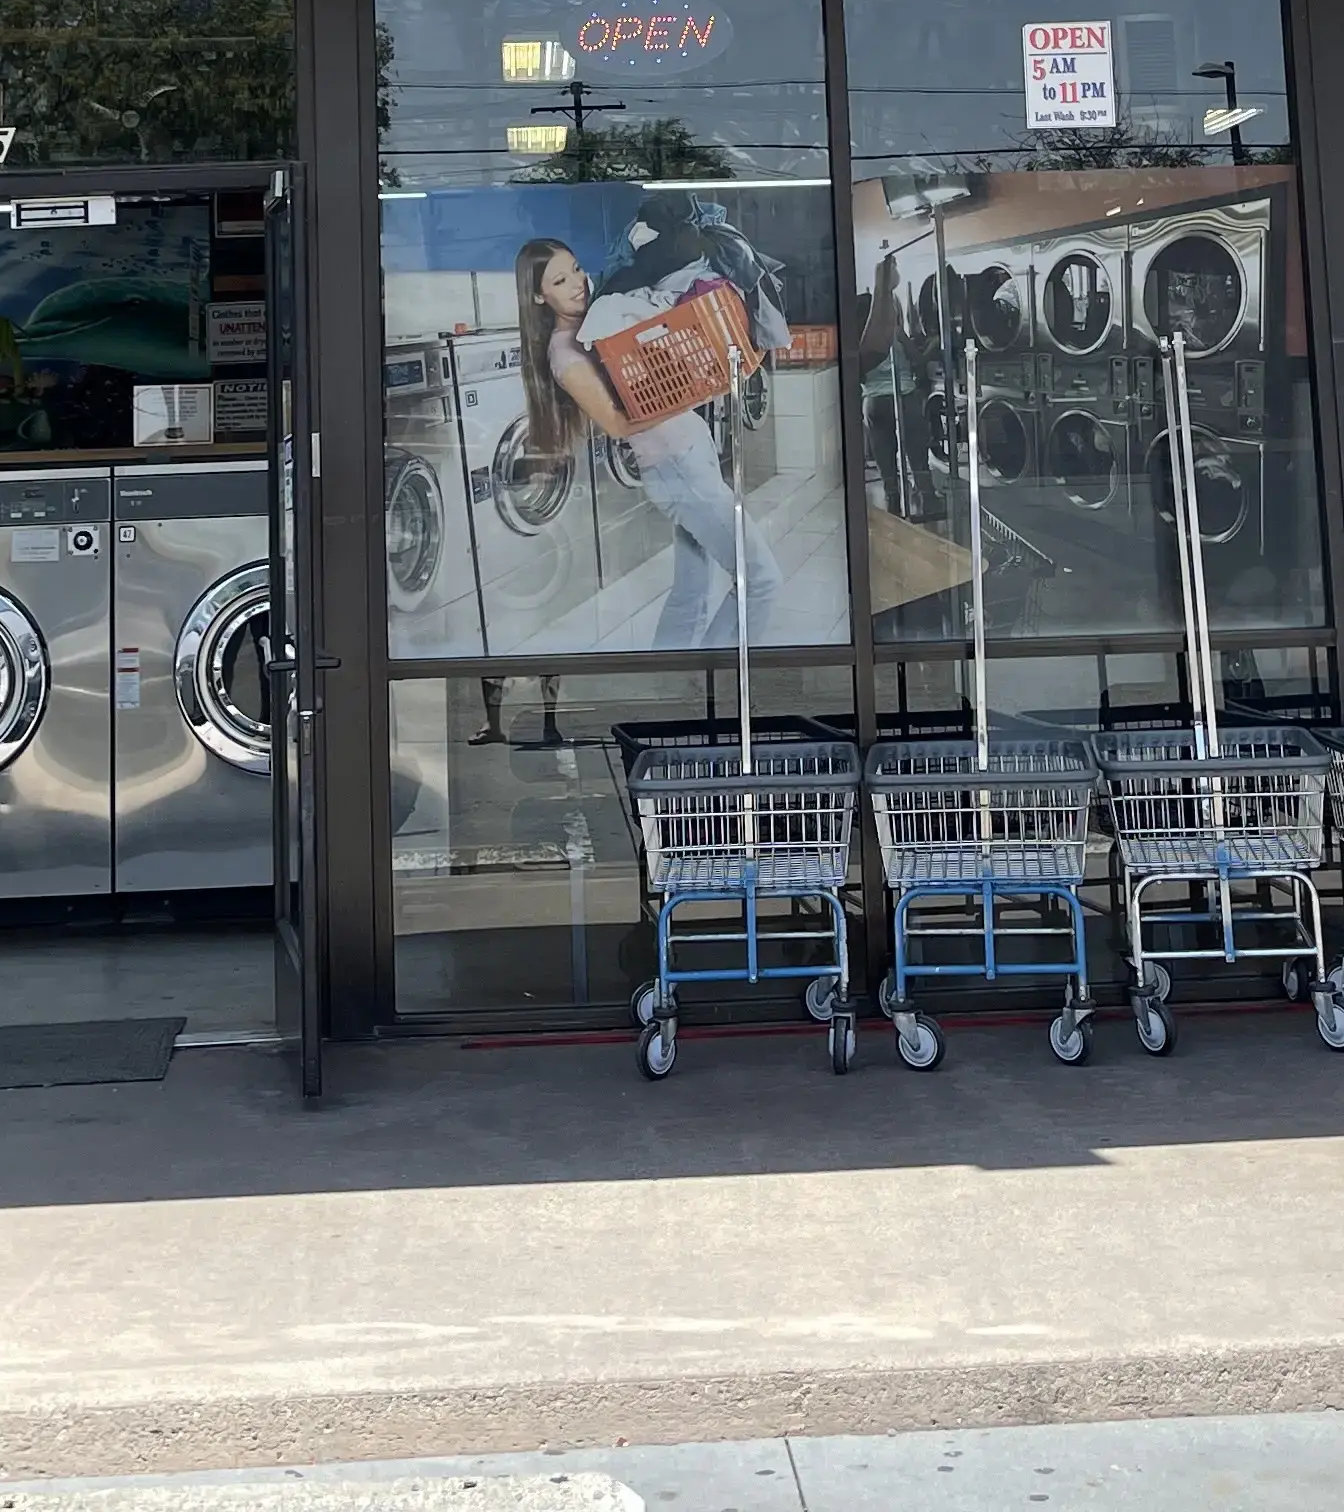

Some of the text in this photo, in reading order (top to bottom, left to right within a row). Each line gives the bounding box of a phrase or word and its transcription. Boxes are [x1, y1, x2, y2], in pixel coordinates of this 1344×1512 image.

[579, 15, 716, 52] OPEN
[1029, 27, 1106, 50] OPEN
[1032, 57, 1077, 81] 5 AM
[1042, 81, 1106, 104] to 11 PM
[1035, 111, 1052, 122] Last
[1053, 110, 1075, 122] Wash
[219, 322, 266, 335] UNATTEN
[223, 384, 267, 393] NOTI
